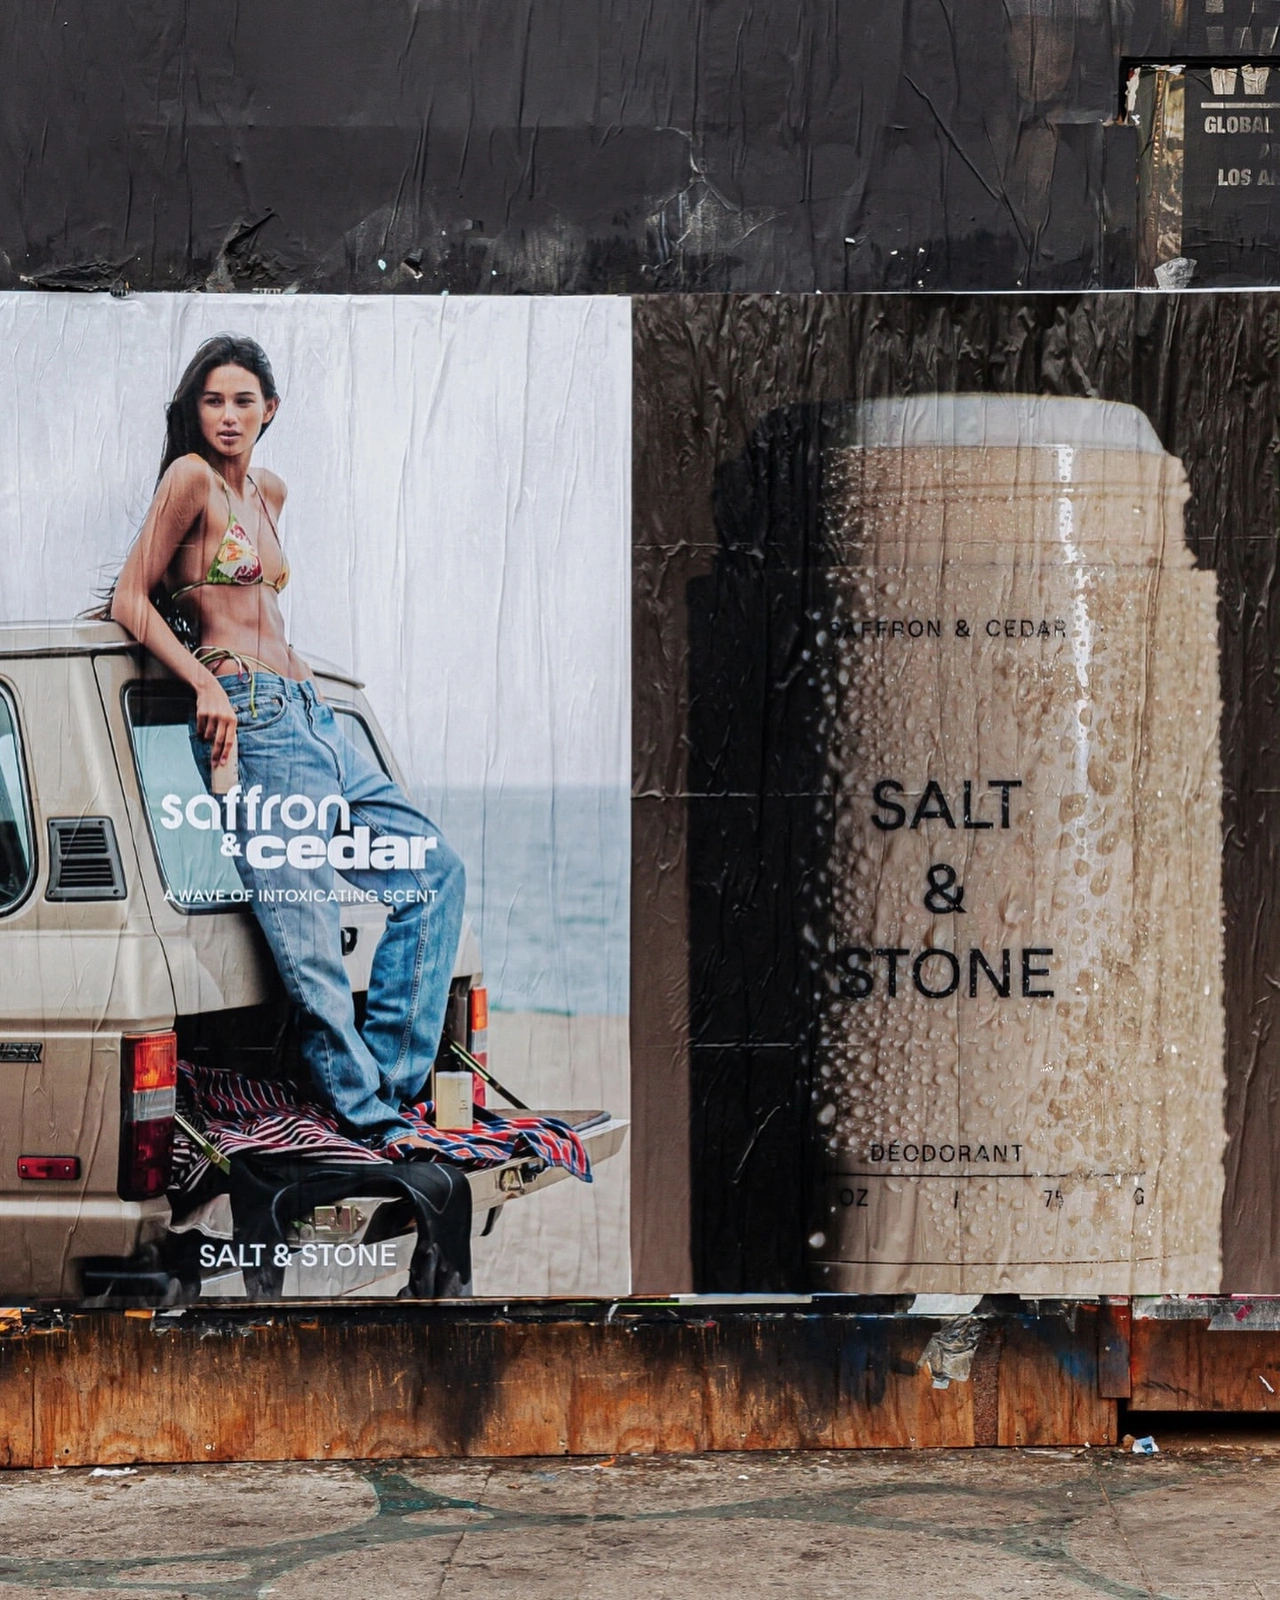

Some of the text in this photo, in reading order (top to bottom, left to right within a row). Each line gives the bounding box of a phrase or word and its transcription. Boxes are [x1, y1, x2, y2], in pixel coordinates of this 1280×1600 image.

[1204, 116, 1274, 134] GLOBAL
[1218, 168, 1252, 187] LOS
[955, 619, 971, 638] &
[986, 618, 1067, 639] CEDAR
[160, 784, 351, 832] saffron
[871, 779, 1023, 831] SALT
[220, 825, 438, 871] & cedar
[163, 889, 439, 903] A WAVE OF INTOXICATING SCENT
[924, 863, 968, 915] &
[839, 947, 1056, 999] STONE
[199, 1243, 397, 1267] SALT & STONE
